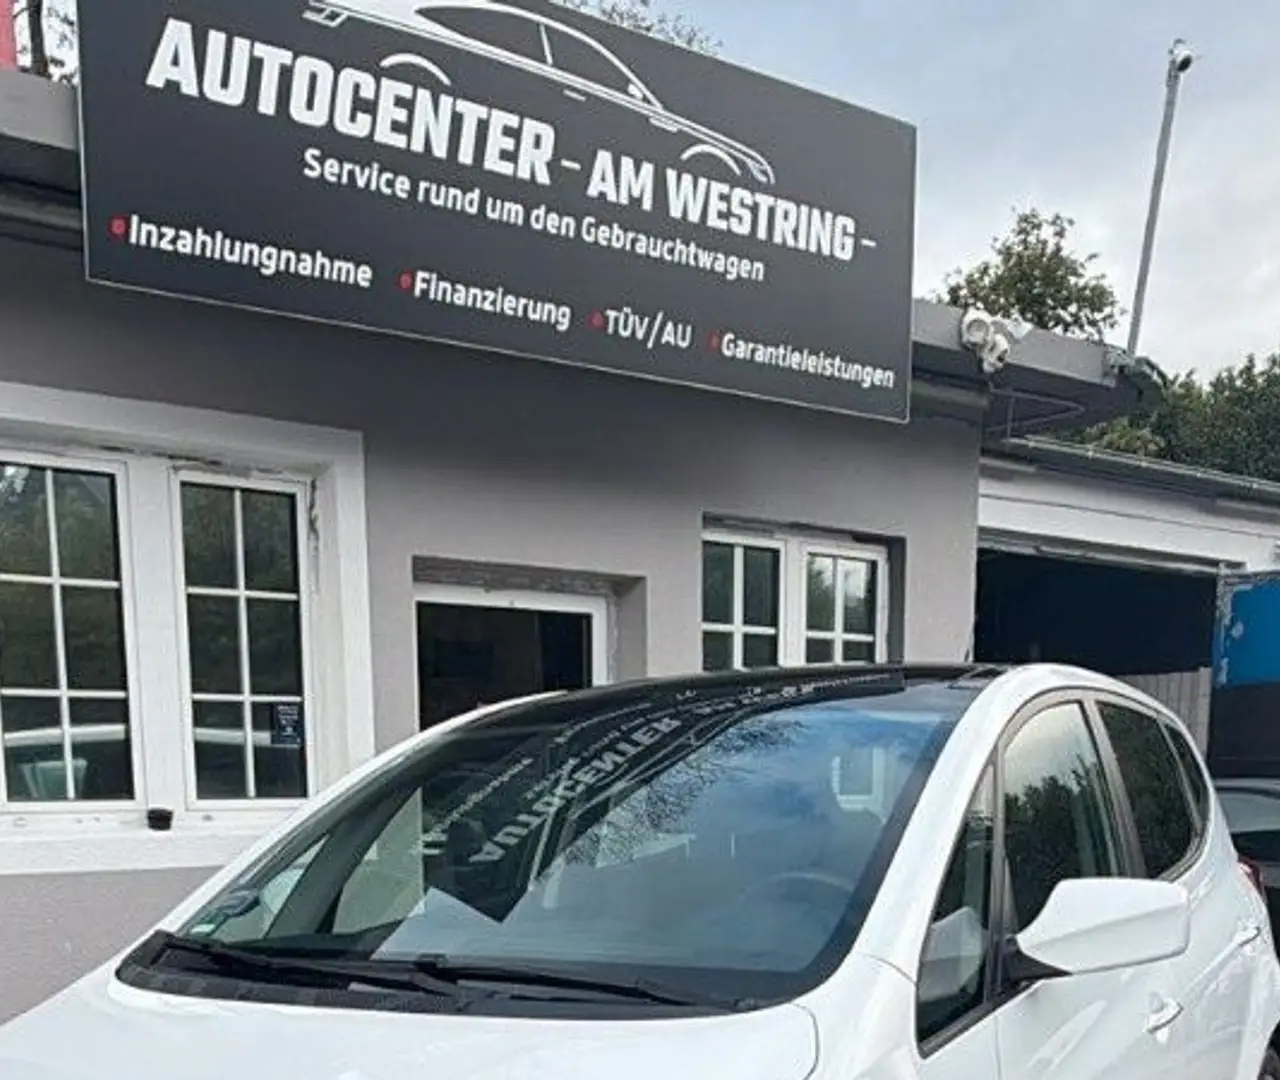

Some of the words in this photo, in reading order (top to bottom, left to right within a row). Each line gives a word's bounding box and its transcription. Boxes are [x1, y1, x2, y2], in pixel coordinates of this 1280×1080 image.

[146, 18, 555, 186] AUTOCENTER
[586, 149, 655, 213] AM
[665, 167, 857, 262] WESTRING
[303, 147, 411, 199] Service
[417, 180, 481, 216] rund
[485, 196, 524, 226] um
[529, 203, 577, 238] den
[581, 215, 766, 283] Gebrauchtwagen
[129, 213, 374, 288] Inzahlungnahme
[414, 270, 571, 332] Finanzierung
[605, 306, 693, 349] TÜV/AU
[721, 331, 896, 390] Garantieleistungen
